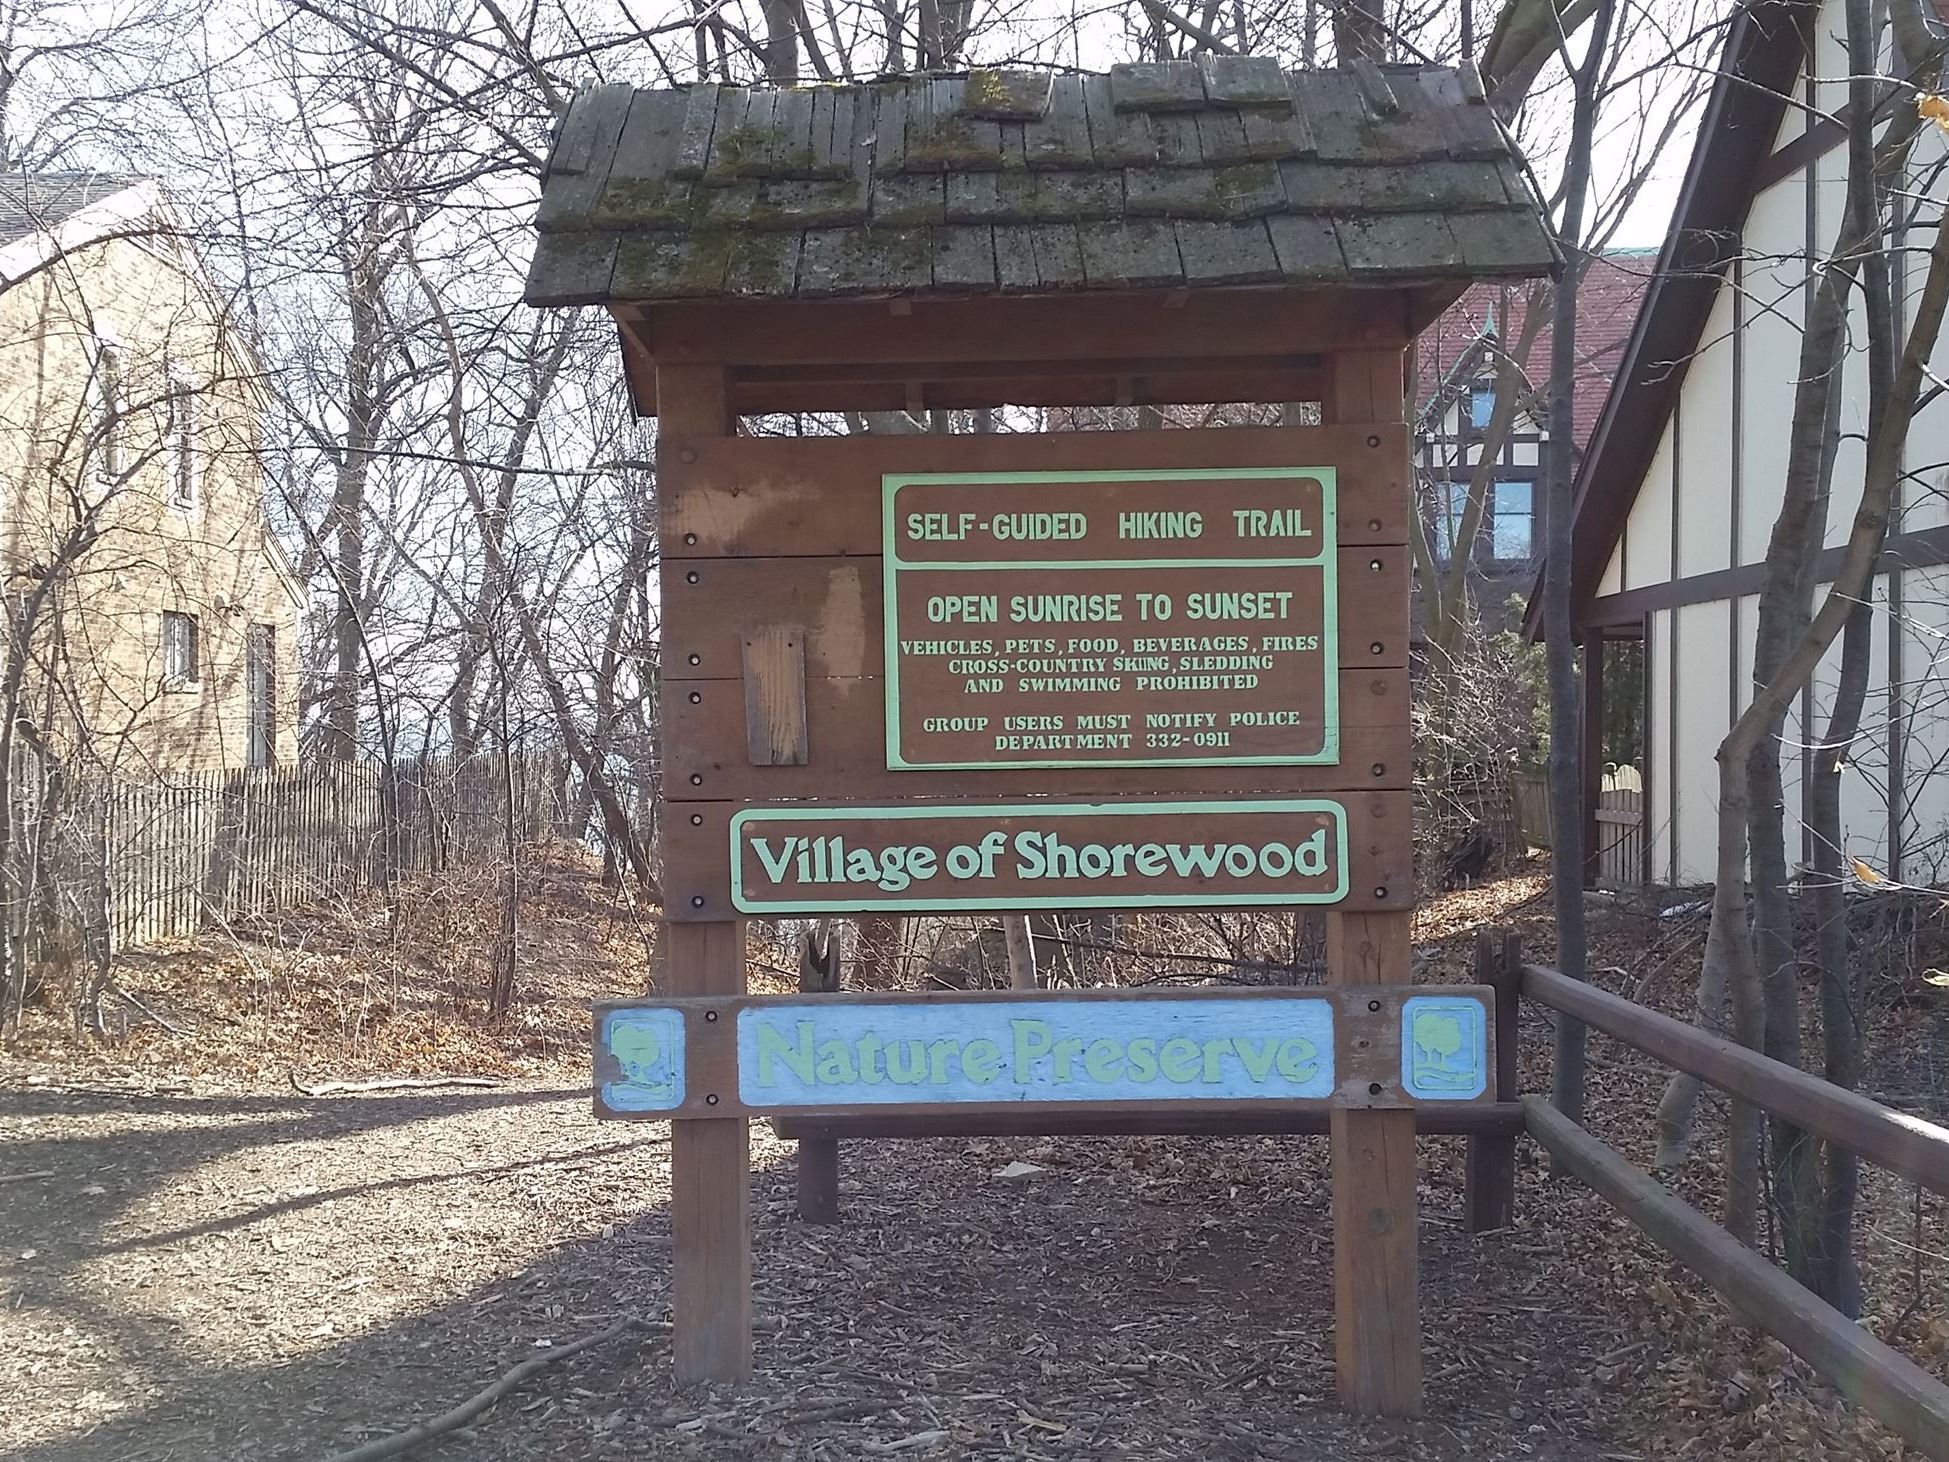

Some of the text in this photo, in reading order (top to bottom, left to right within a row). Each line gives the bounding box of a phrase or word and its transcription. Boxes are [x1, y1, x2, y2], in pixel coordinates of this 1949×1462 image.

[907, 509, 1312, 541] SELF-GUIDED HIKING TRAIL
[927, 592, 1293, 622] OPEN SUNRISE TO SUNSET
[901, 636, 1318, 656] VEHICLES, PETS, FOOD, BEVERAGES, FIRES
[948, 658, 1105, 674] CROSS-COUNTRY
[1179, 656, 1274, 671] SLEDDING
[964, 675, 1258, 693] AND SWIMMING PROHIBITED
[923, 712, 1300, 733] GROUP USERS MUST NOTIFY POLICE
[996, 732, 1230, 750] DEPARTMENT 332-0911
[750, 828, 1328, 892] Village of Shorewood
[756, 1019, 1319, 1087] Nature Preserve
